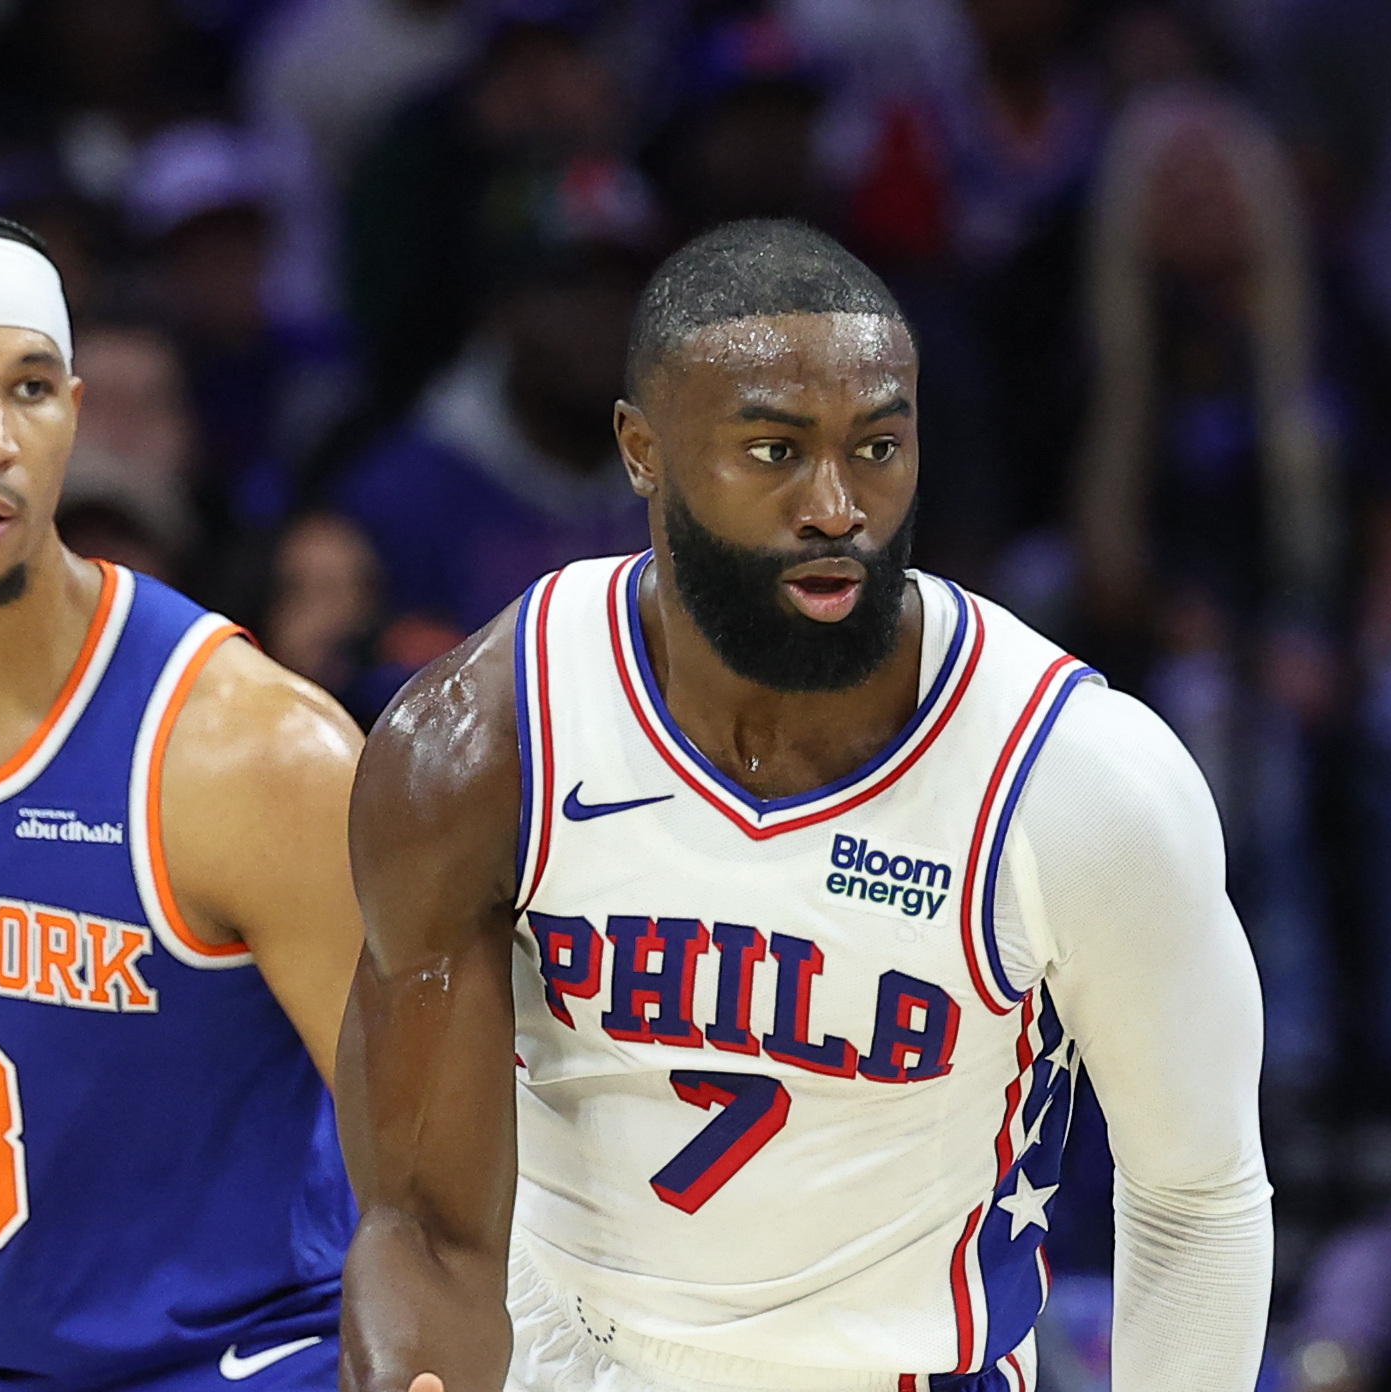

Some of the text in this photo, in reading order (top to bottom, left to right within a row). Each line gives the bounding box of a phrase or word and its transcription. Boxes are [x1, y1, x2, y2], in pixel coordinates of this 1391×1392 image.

[15, 818, 123, 844] abu dhabi
[830, 833, 952, 890] Bloom
[826, 872, 947, 920] energy
[526, 909, 962, 1084] PHILA
[648, 1069, 792, 1215] 7
